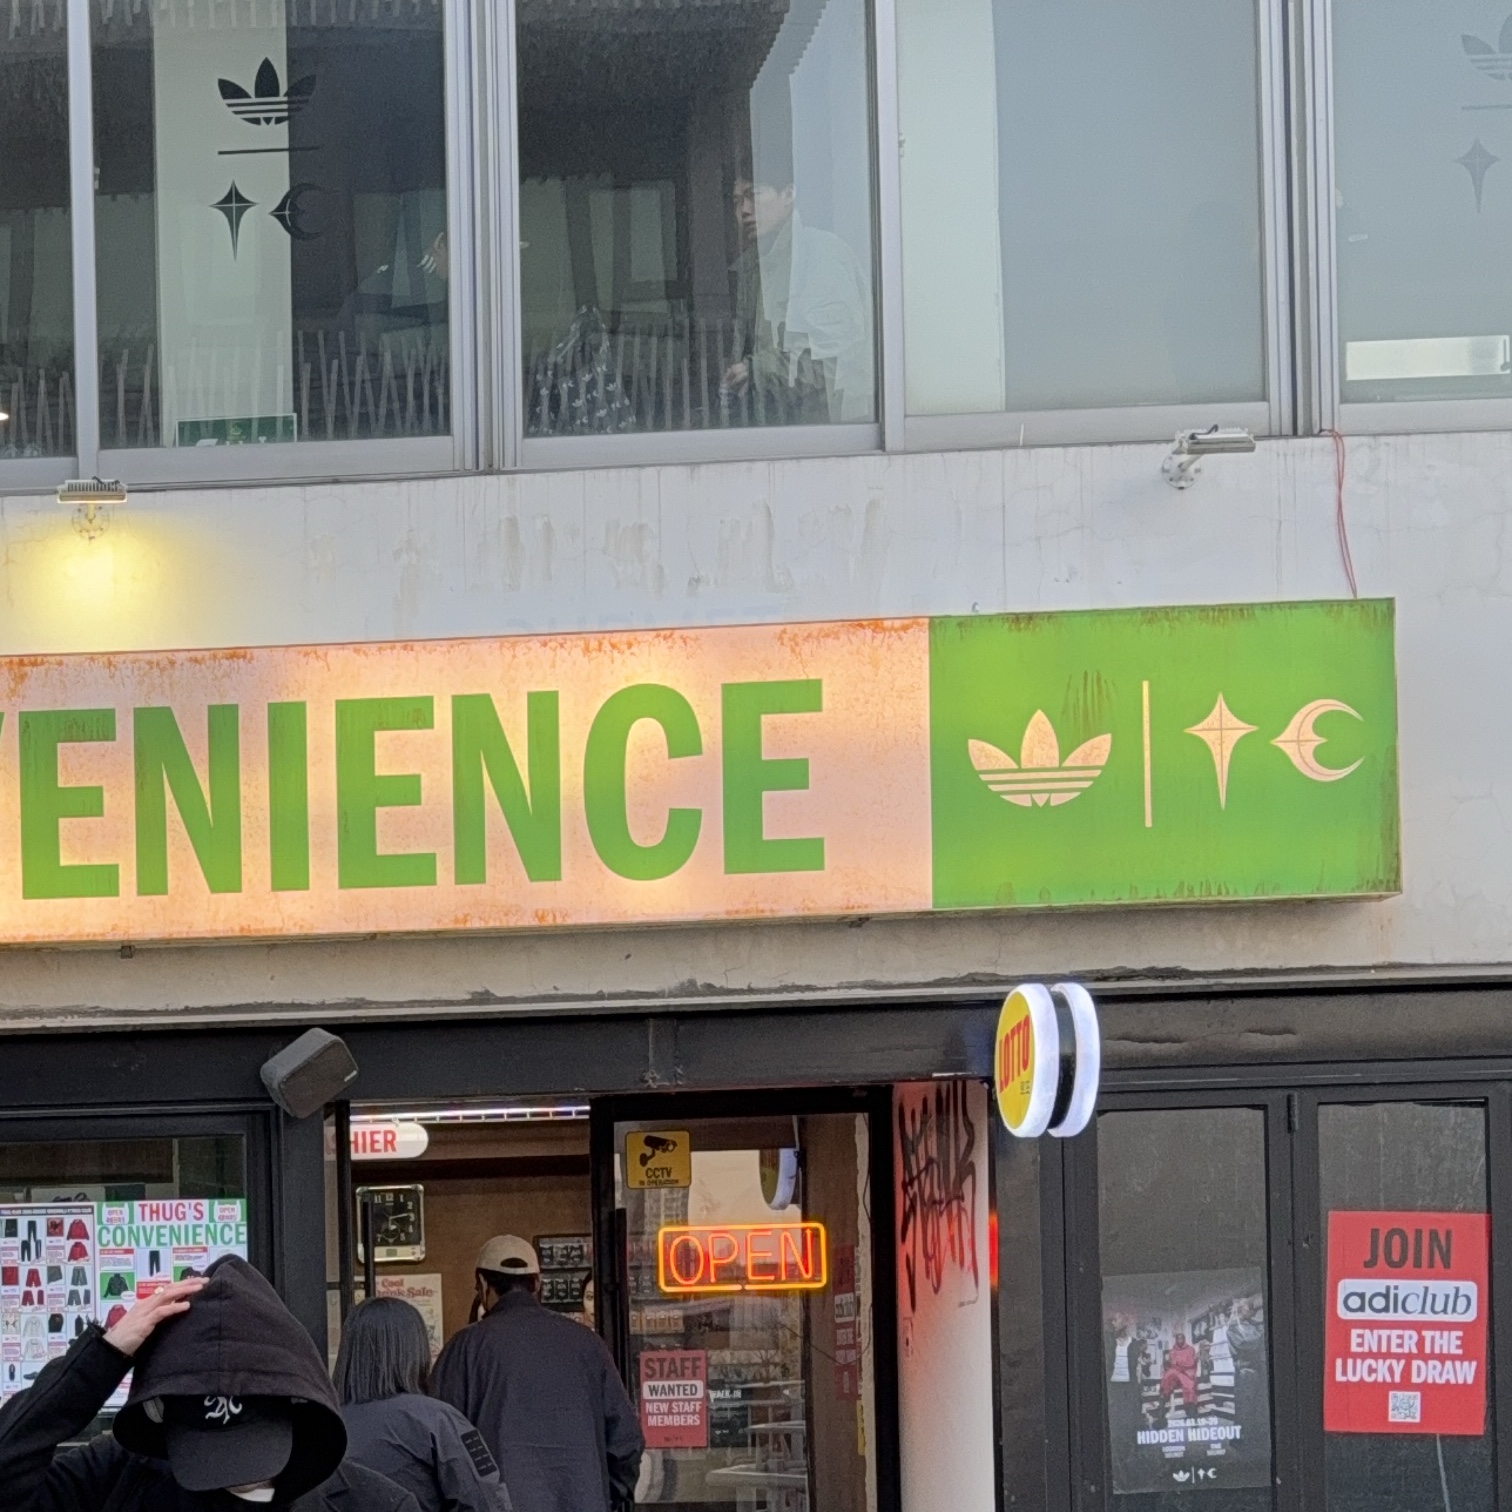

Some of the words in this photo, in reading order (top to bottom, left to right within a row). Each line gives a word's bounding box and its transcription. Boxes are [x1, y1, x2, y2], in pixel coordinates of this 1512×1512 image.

[998, 1013, 1030, 1095] LOTTO
[645, 1167, 672, 1179] CCTV
[138, 1202, 204, 1222] THUG'S
[97, 1223, 246, 1247] CONVENIENCE
[669, 1228, 813, 1285] OPEN
[1363, 1227, 1453, 1270] JOIN
[1343, 1285, 1472, 1316] adiclub
[1350, 1328, 1419, 1354] ENTER
[1422, 1330, 1464, 1355] THE
[644, 1357, 701, 1379] STAFF
[1335, 1357, 1406, 1383] LUCKY
[1411, 1360, 1477, 1385] DRAW
[648, 1383, 698, 1397] WANTED
[646, 1402, 669, 1414] NEW
[672, 1401, 702, 1413] STAFF
[648, 1414, 700, 1427] MEMBERS
[1137, 1428, 1184, 1445] HIDDEN
[1187, 1425, 1242, 1442] HIDEOUT
